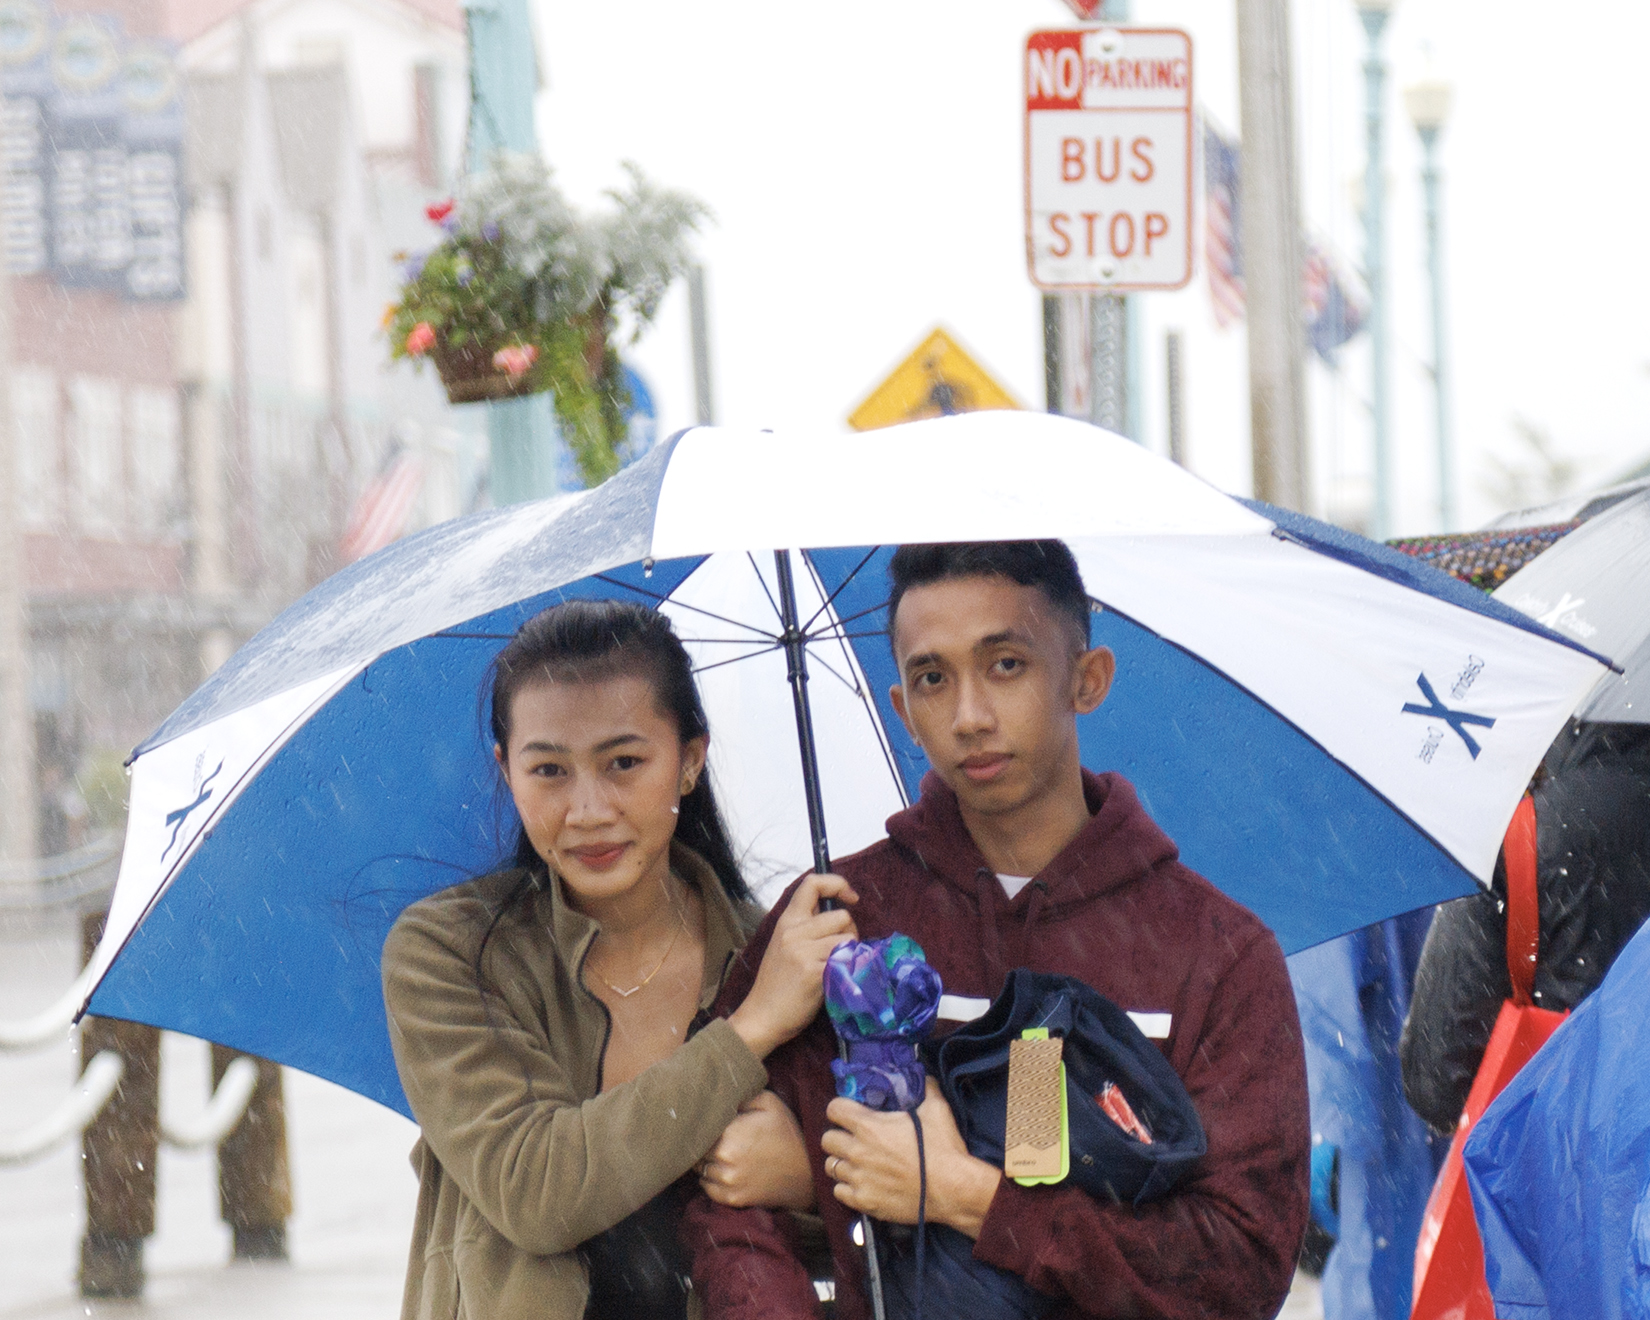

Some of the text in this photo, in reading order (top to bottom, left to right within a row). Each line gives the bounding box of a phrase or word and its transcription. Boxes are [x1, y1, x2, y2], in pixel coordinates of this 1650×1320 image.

[1028, 48, 1188, 99] NO PARKING
[1060, 136, 1155, 183] BUS
[1048, 211, 1169, 258] STOP
